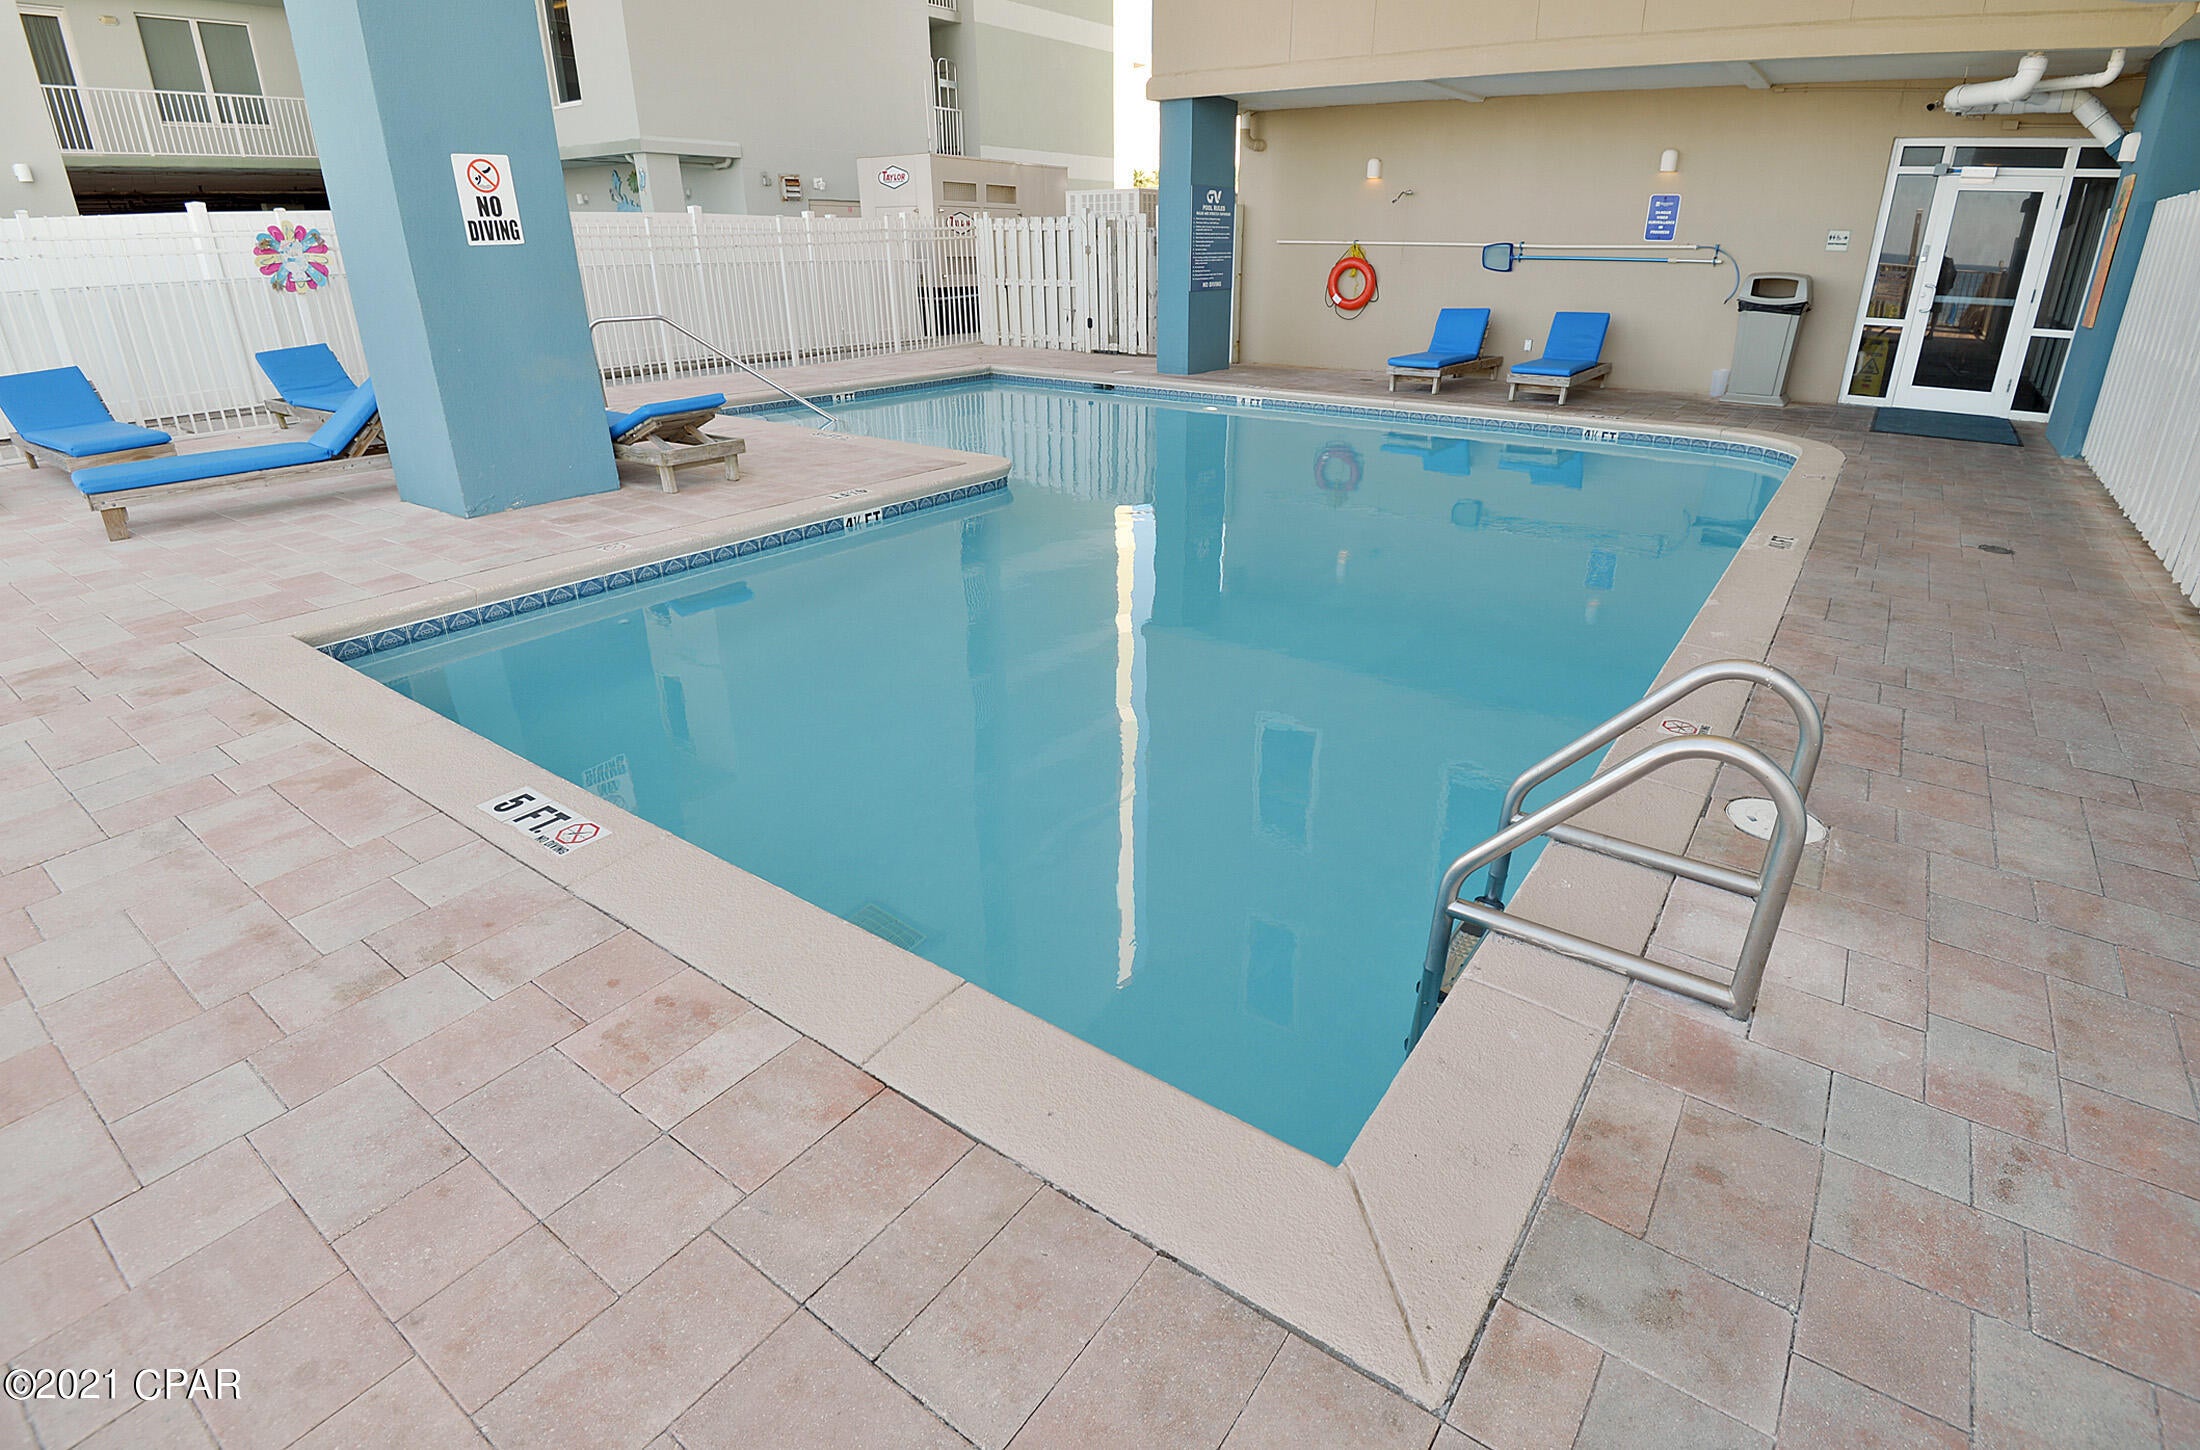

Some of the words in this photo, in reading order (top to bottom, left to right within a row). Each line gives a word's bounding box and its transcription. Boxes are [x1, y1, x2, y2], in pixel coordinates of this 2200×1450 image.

[882, 170, 906, 181] TAYLOR
[476, 195, 503, 217] NO
[1206, 189, 1222, 204] GV
[467, 219, 521, 242] DIVING
[1601, 431, 1617, 439] FT
[864, 510, 881, 524] FT
[493, 793, 537, 813] 5
[512, 805, 572, 834] FT.
[535, 835, 550, 843] NO
[544, 840, 570, 855] DIVING
